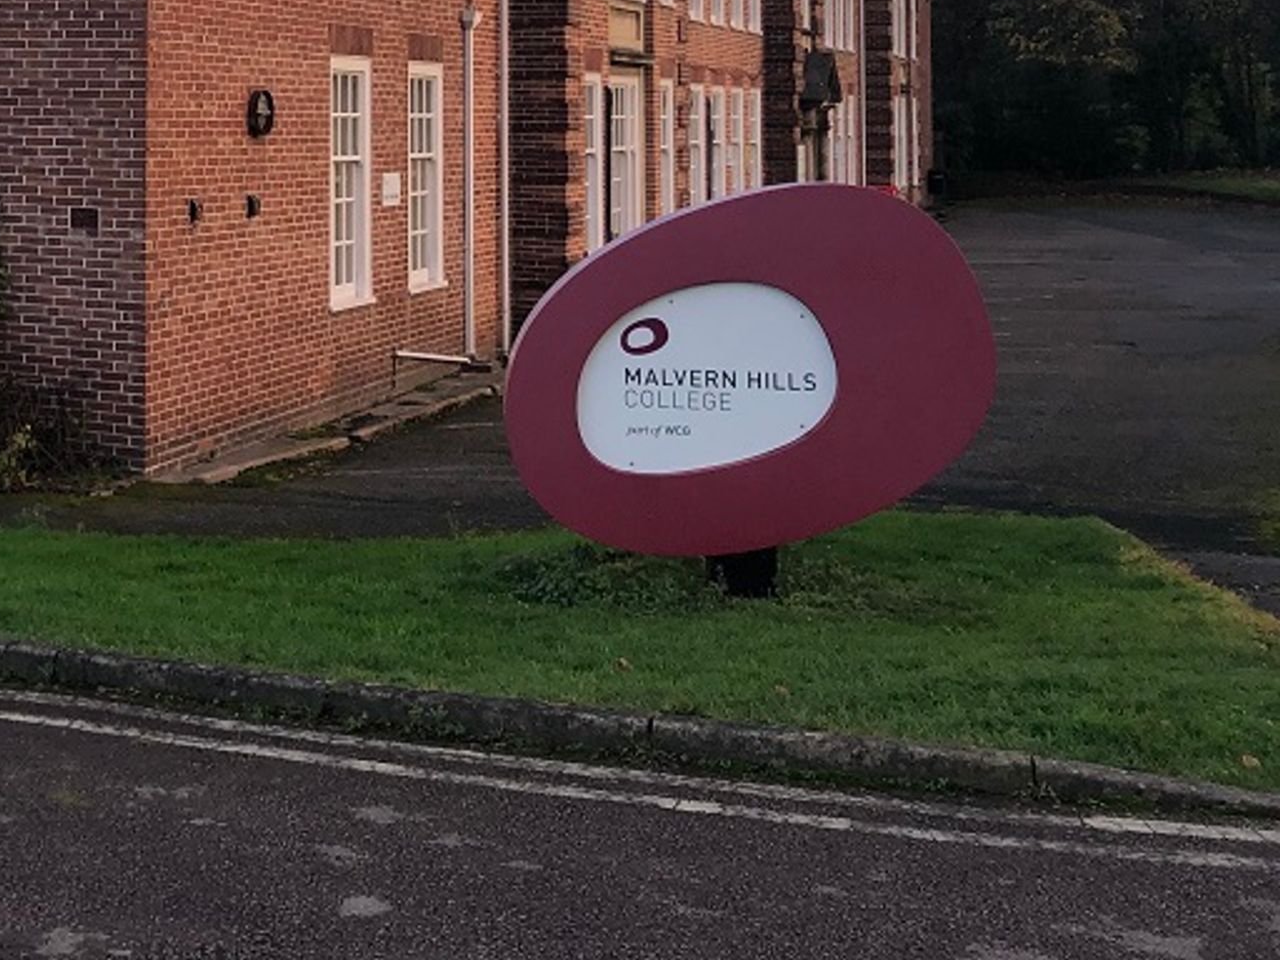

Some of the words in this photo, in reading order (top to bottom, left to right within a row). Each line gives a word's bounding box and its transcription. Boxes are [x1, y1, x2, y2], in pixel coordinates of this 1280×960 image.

[624, 367, 738, 390] MALVERN
[746, 371, 818, 392] HILLS
[624, 390, 733, 412] COLLEGE
[624, 424, 649, 438] part
[650, 424, 662, 439] of
[664, 423, 692, 437] WCG
